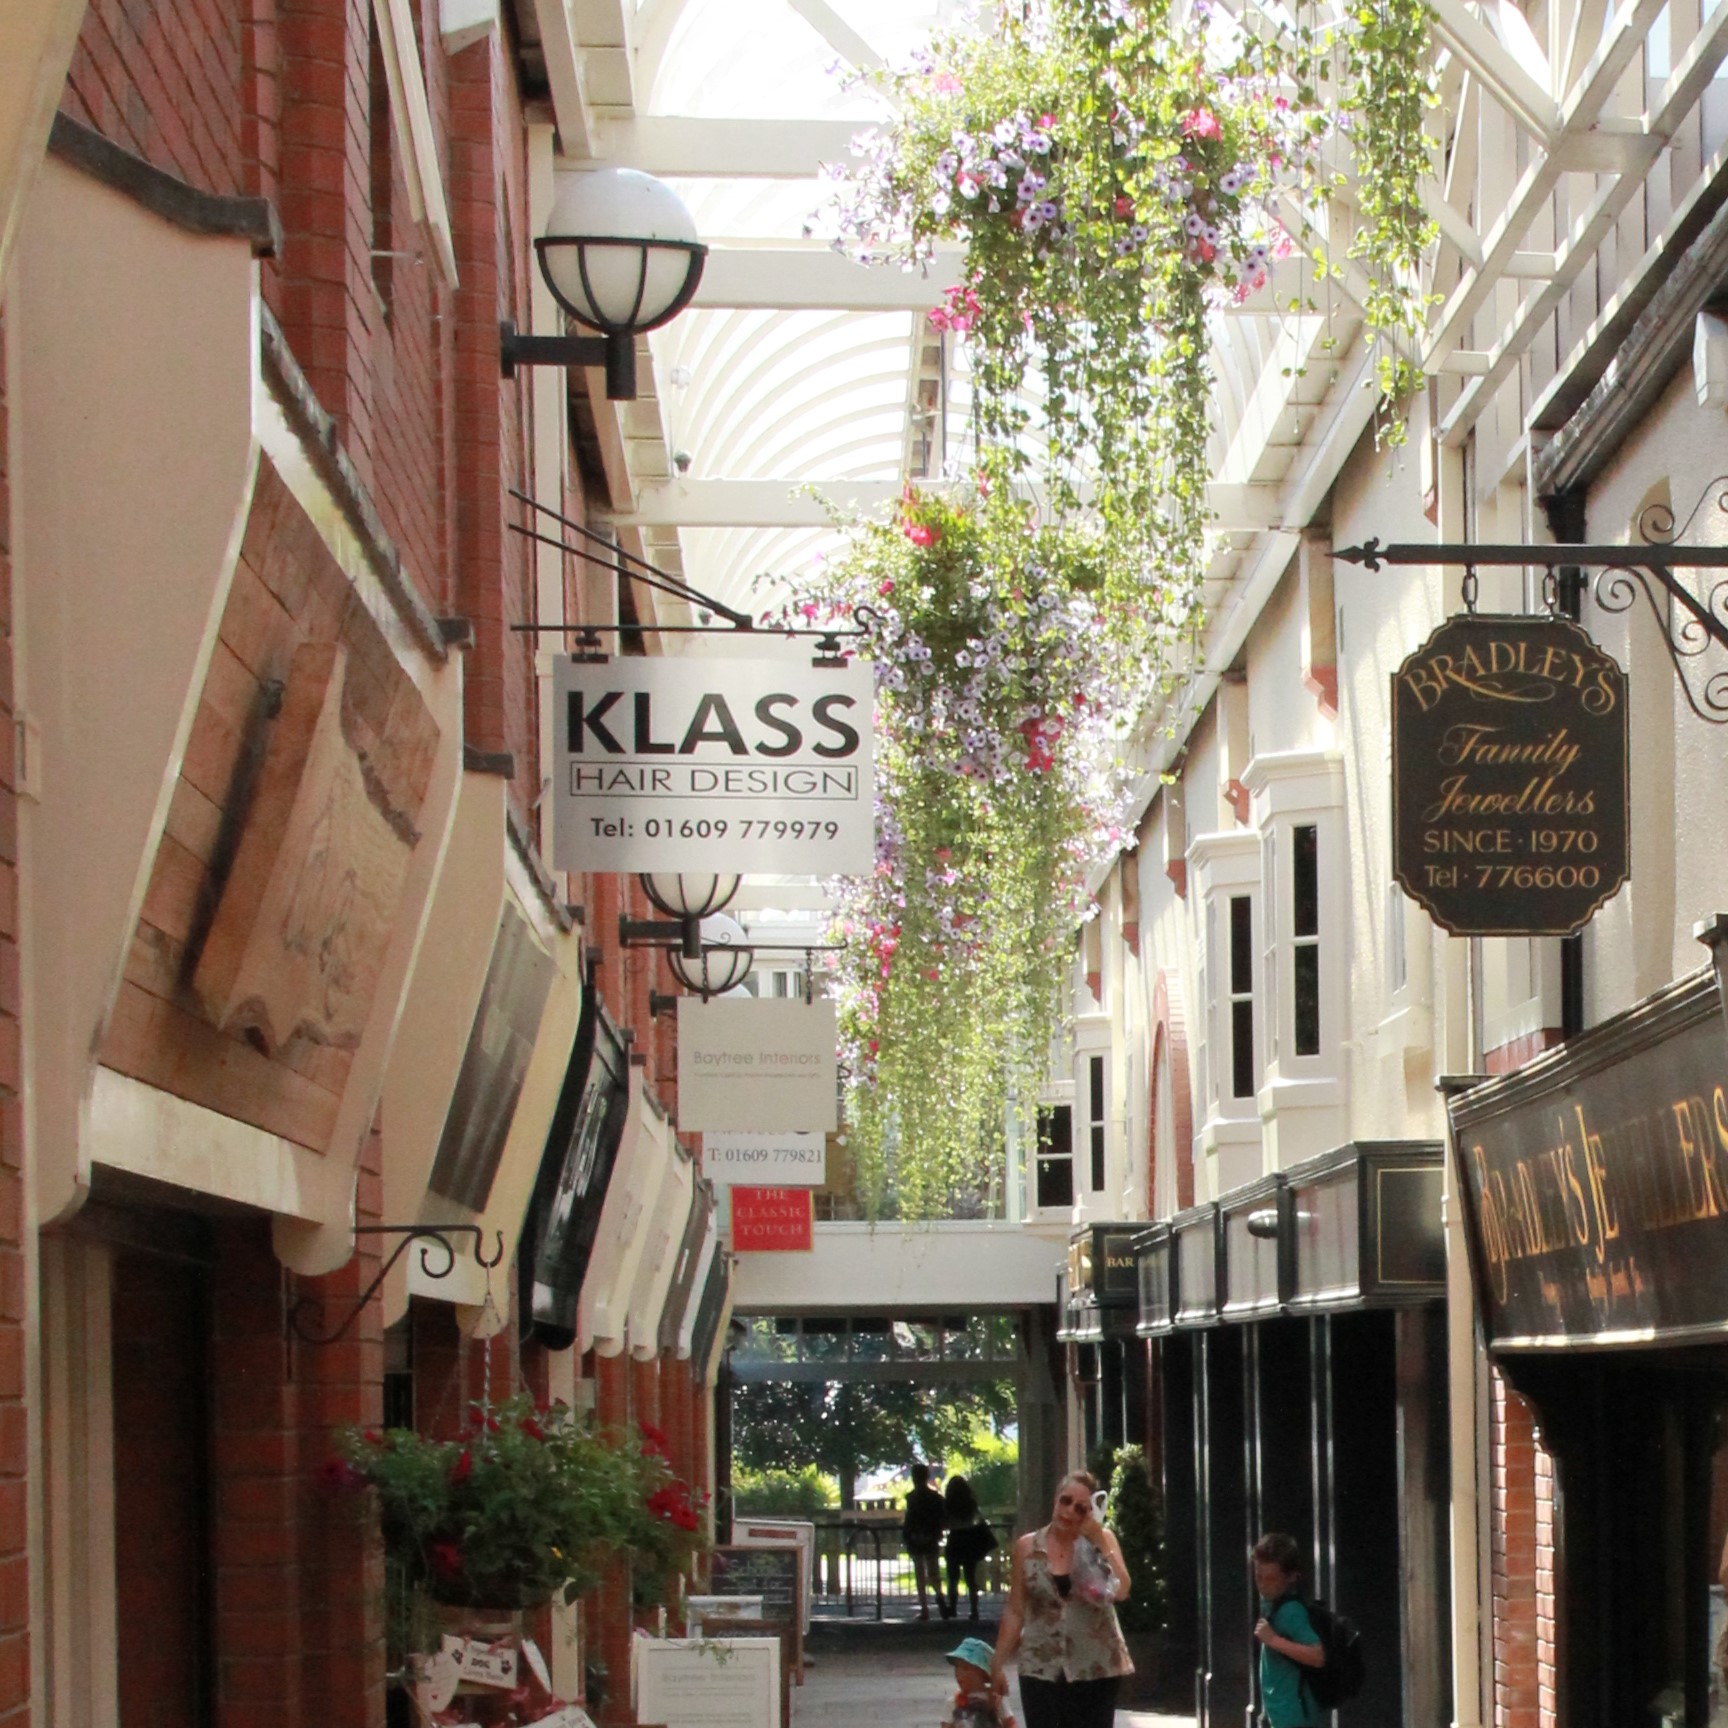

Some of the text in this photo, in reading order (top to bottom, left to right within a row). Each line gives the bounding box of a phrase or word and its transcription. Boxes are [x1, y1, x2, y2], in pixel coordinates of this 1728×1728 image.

[1404, 641, 1616, 715] BRADLEY'S
[568, 691, 860, 758] KLASS
[1439, 722, 1582, 776] Family
[576, 768, 852, 794] HAIR DESIGN
[1421, 774, 1595, 823] Jewellers
[590, 818, 839, 840] Tel: 01609 779979
[1424, 830, 1598, 853] SINCE 1970
[1424, 865, 1600, 888] Tel 776600
[694, 1052, 821, 1066] Baytree Interiors
[708, 1148, 822, 1163] T: 01609 779821
[756, 1189, 787, 1200] THE
[736, 1206, 805, 1218] CLASSIC
[741, 1224, 803, 1236] TOUCH
